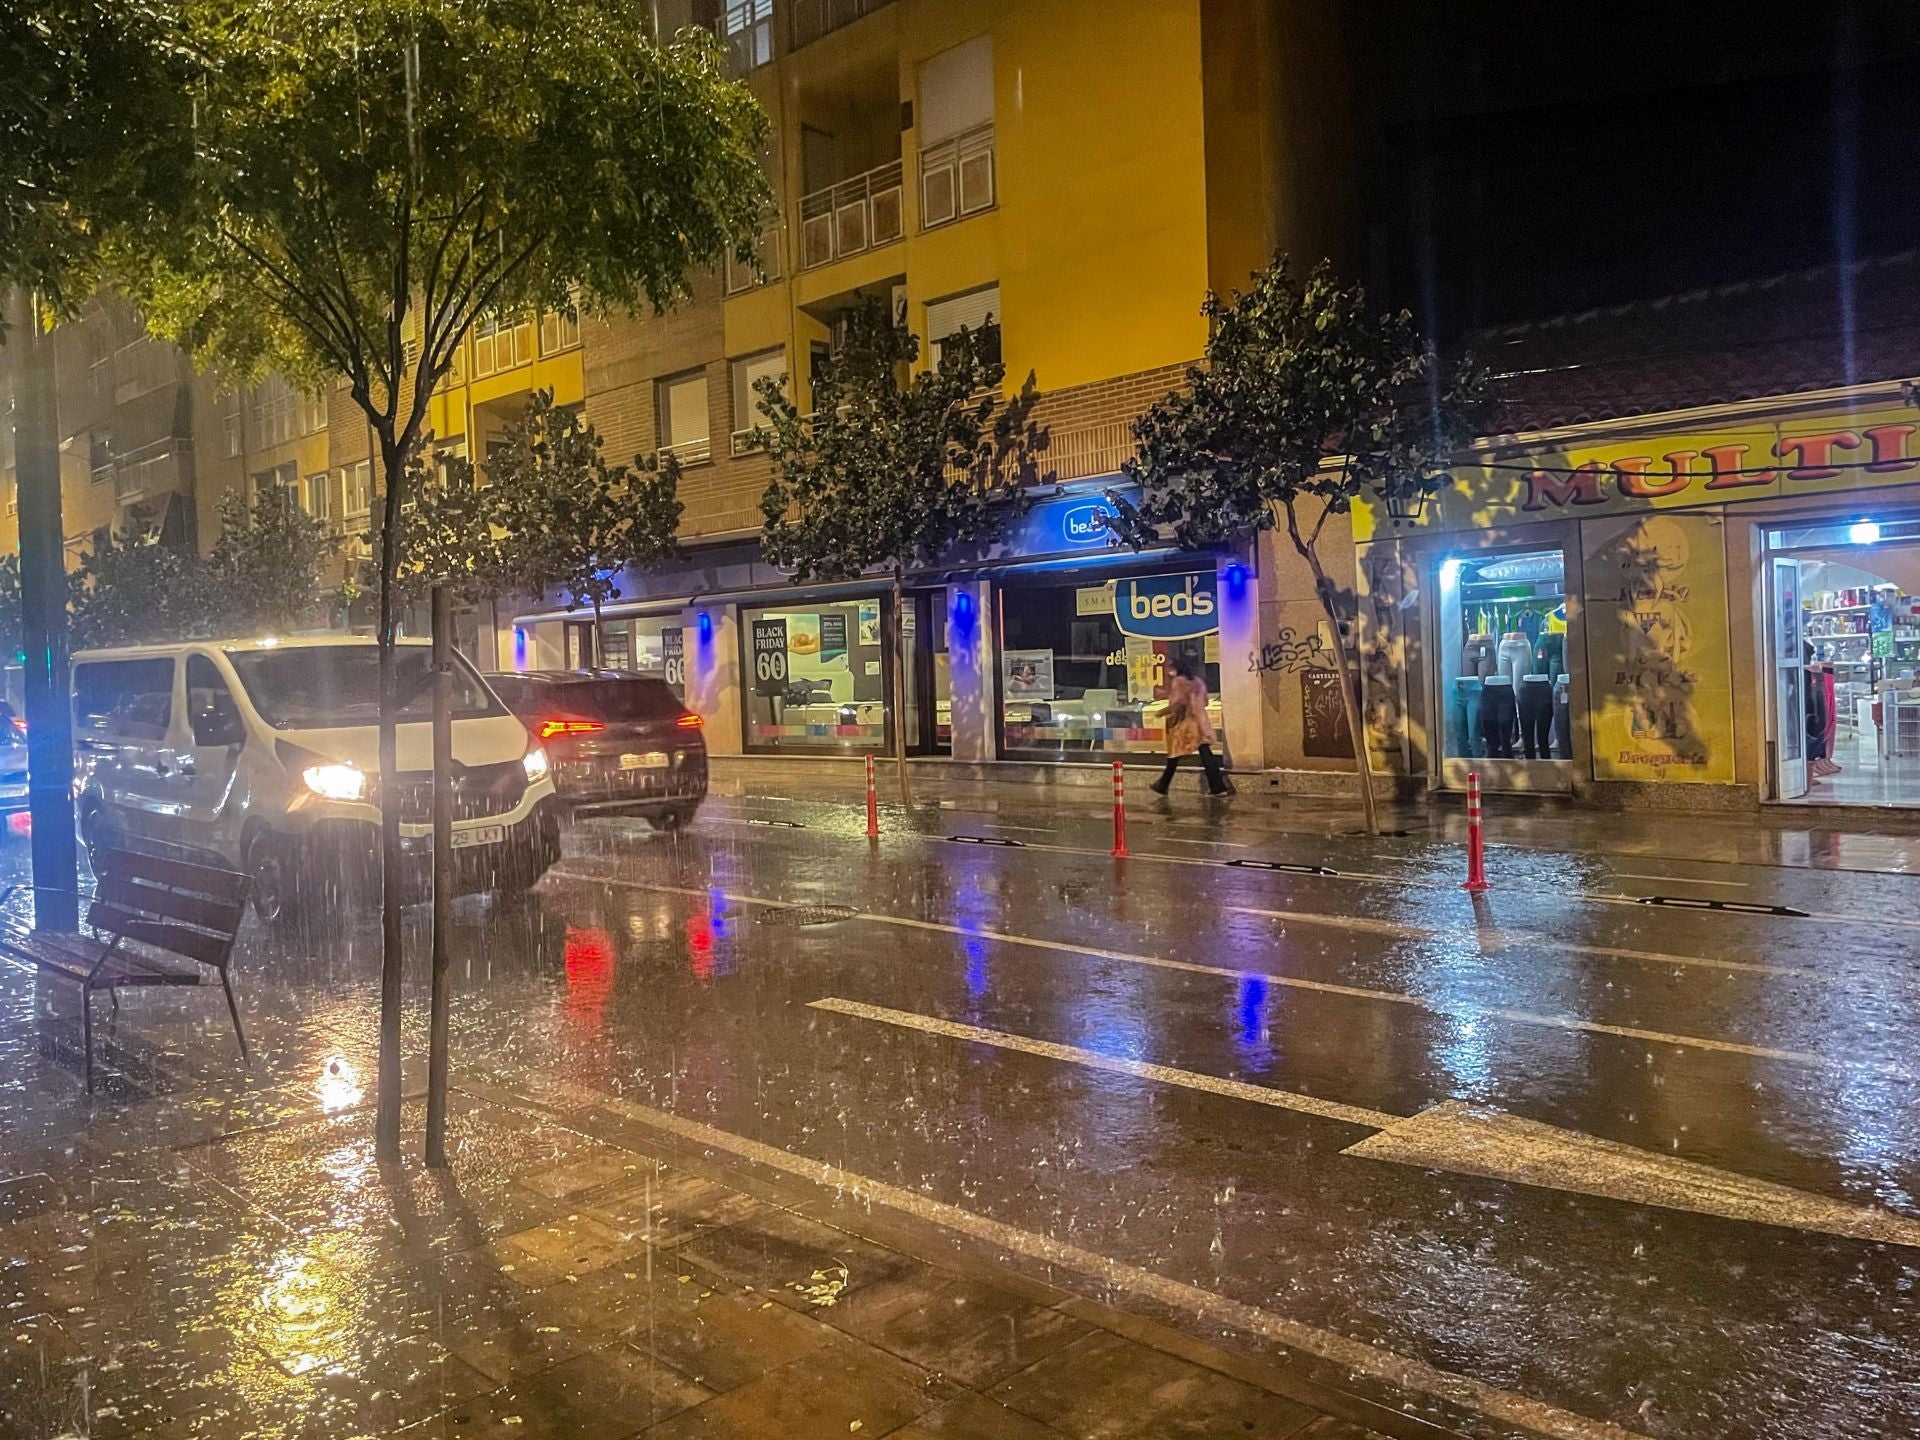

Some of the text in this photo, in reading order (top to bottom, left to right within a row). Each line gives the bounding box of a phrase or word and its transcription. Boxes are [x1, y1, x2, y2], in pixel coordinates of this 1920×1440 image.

[1521, 424, 1918, 512] MULTI
[1130, 575, 1214, 619] bed's
[756, 626, 784, 638] BLACK
[665, 635, 683, 646] BLAC
[756, 638, 785, 650] FRIDAY
[665, 645, 683, 656] FRID
[757, 651, 787, 681] 60
[1105, 651, 1166, 666] desanso
[452, 831, 469, 846] 29
